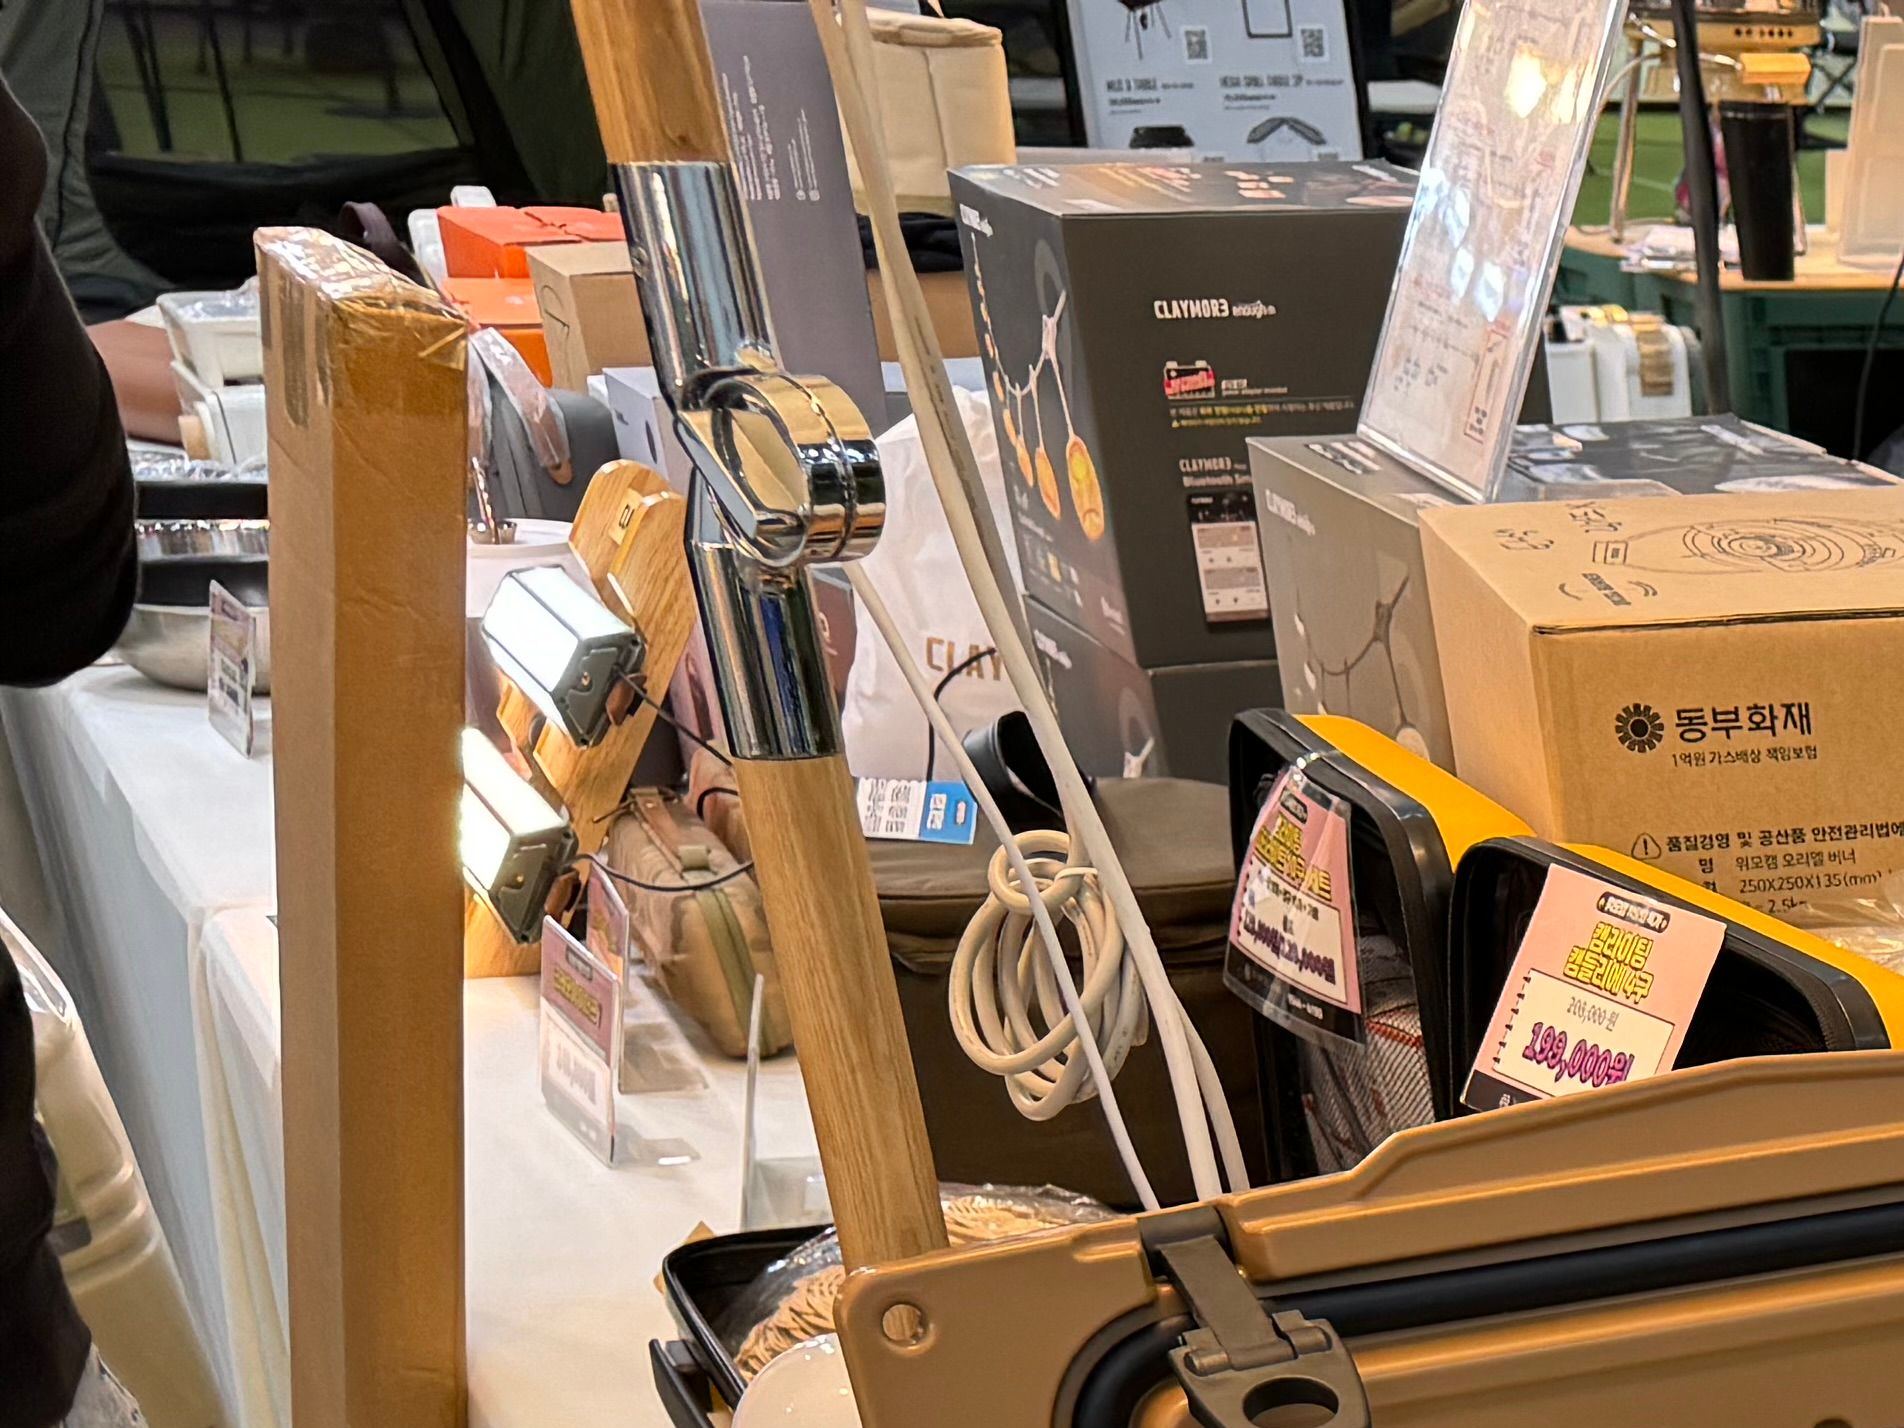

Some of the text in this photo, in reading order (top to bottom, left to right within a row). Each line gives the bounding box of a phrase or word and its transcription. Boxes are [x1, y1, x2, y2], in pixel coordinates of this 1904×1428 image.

[1675, 703, 1813, 743] 동부화재
[1666, 832, 1731, 854] 품질경영
[1737, 830, 1754, 850] 및
[1758, 827, 1807, 848] 공산품
